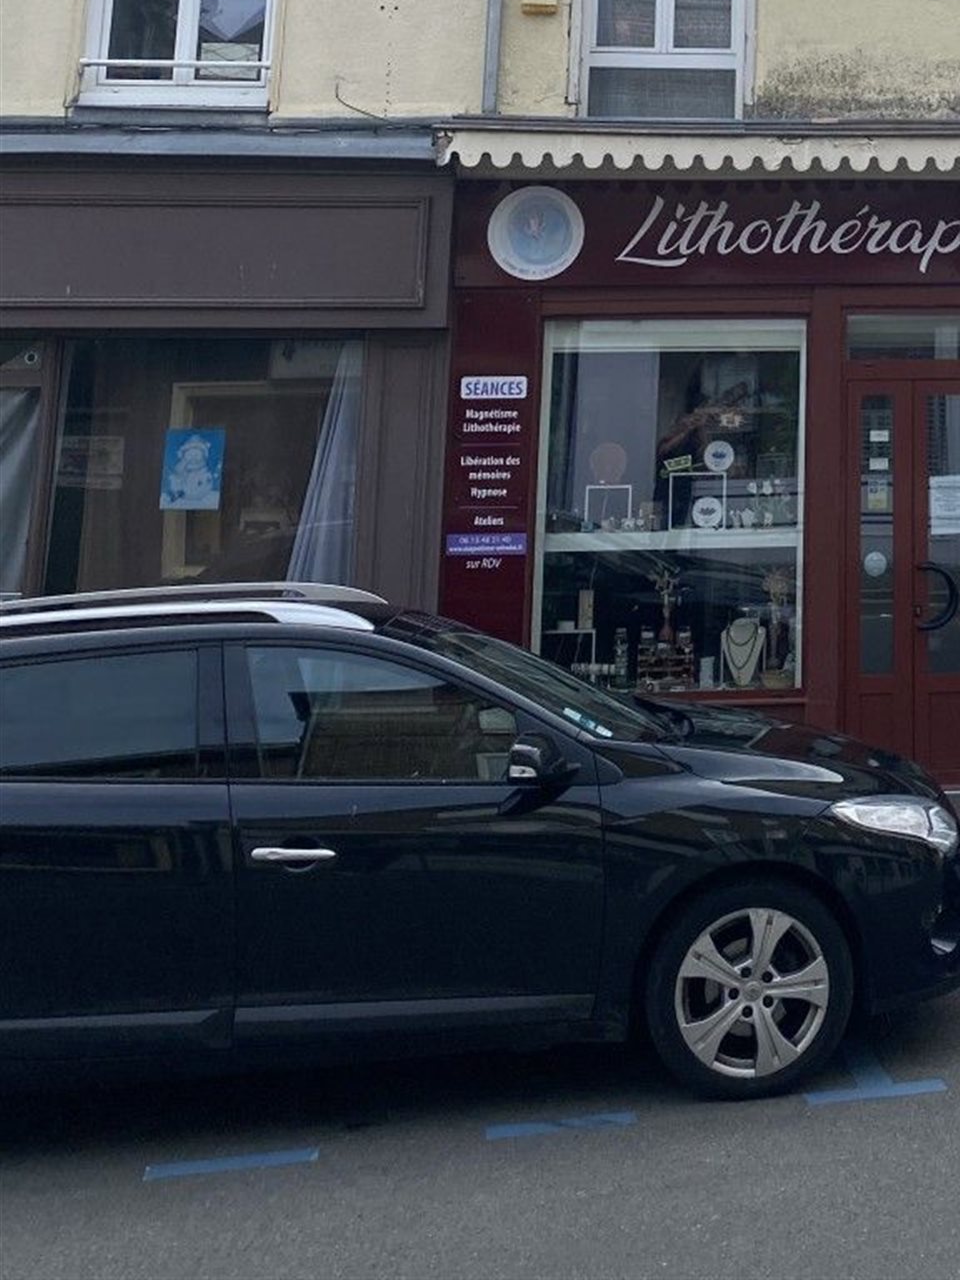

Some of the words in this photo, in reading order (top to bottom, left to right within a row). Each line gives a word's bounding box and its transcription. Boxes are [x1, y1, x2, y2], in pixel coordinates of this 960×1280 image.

[464, 379, 523, 396] SÉANCES
[465, 408, 519, 421] Magnétisme
[462, 422, 521, 435] Lithothérapie
[460, 455, 503, 466] Libération
[505, 455, 521, 466] des
[468, 468, 511, 480] mémoires
[470, 487, 508, 498] Hypnose
[474, 515, 505, 526] Ateliers
[465, 560, 480, 570] sur
[481, 557, 503, 569] RDV
